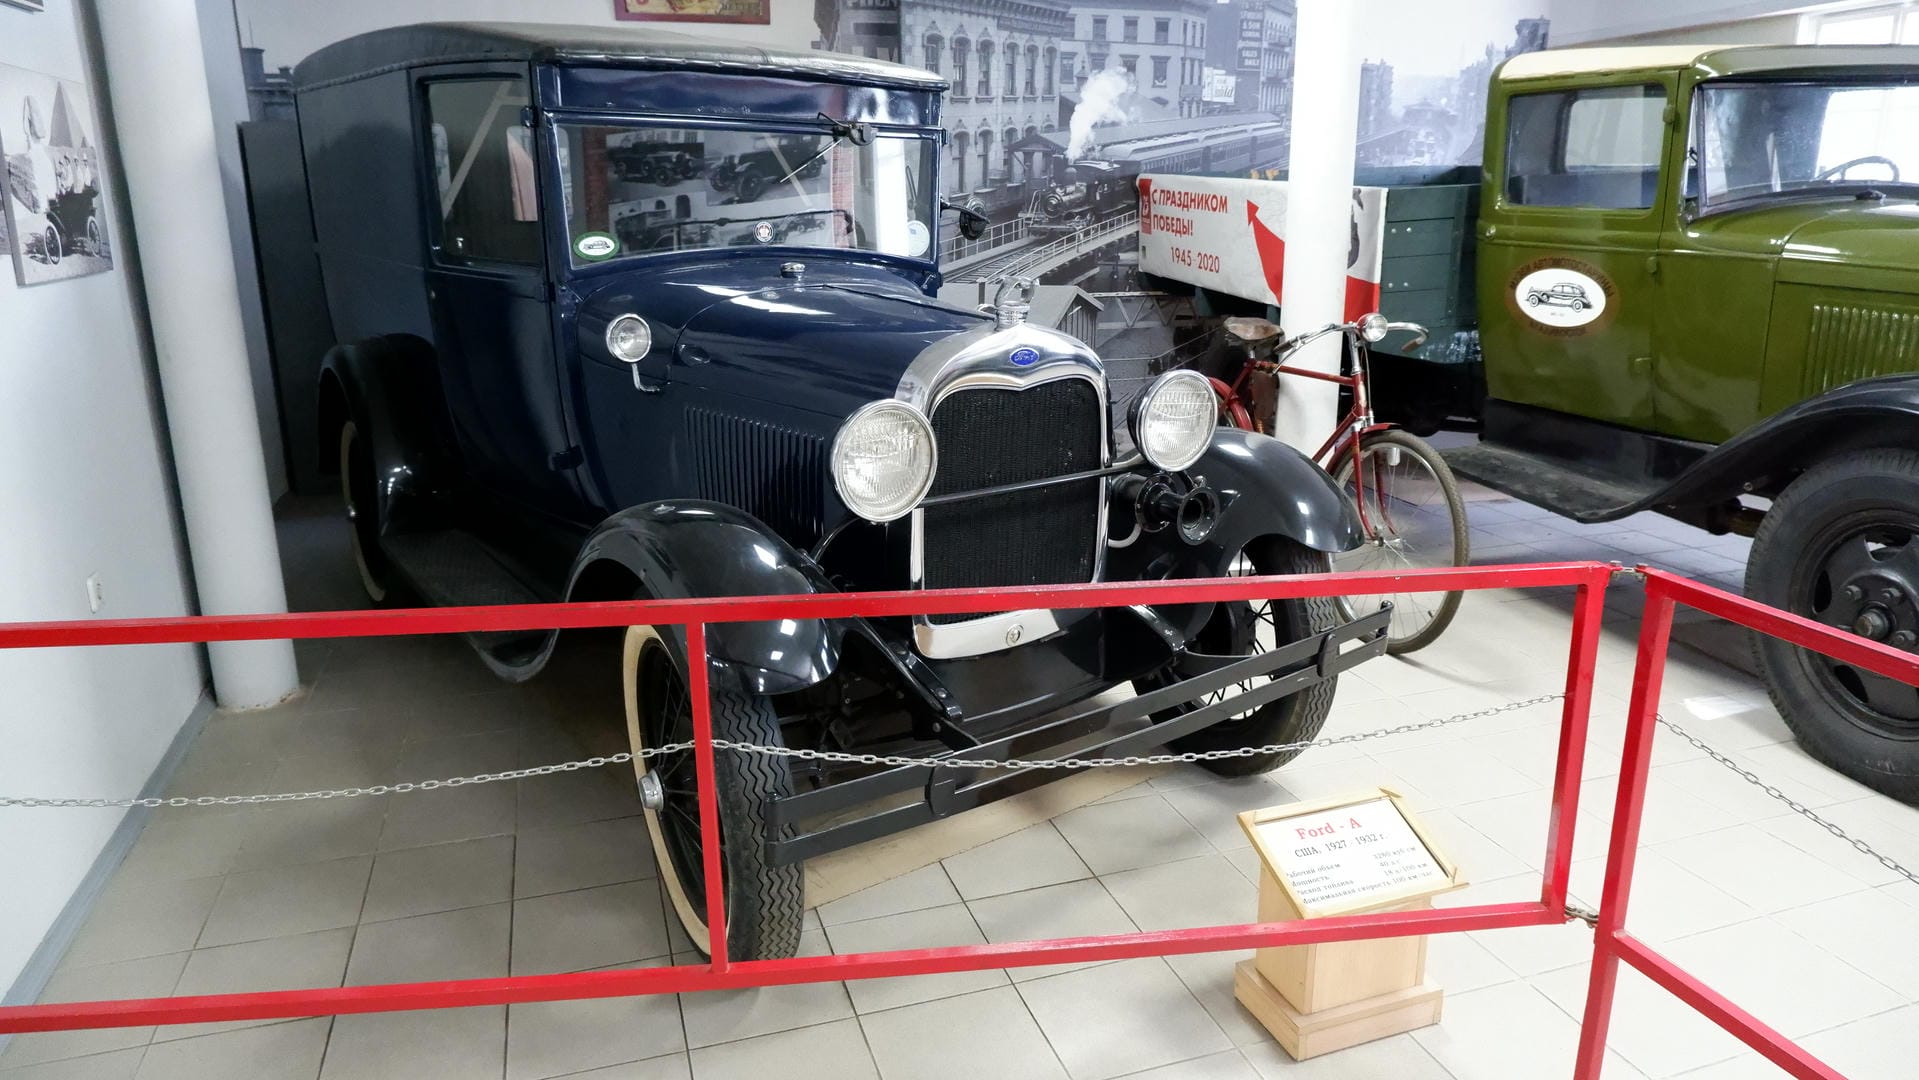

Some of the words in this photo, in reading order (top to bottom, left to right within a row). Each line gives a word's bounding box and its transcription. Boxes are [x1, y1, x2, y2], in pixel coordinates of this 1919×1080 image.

[1151, 189, 1159, 206] С
[1159, 189, 1228, 214] ПРАЗДНИКОМ
[1152, 214, 1194, 237] ПОБЕДЫ!
[1295, 823, 1336, 840] Ford
[1350, 818, 1362, 829] A
[1294, 843, 1322, 858] США,
[1325, 839, 1347, 853] 1927
[1355, 833, 1379, 846] 1932
[1357, 881, 1391, 893] скорость
